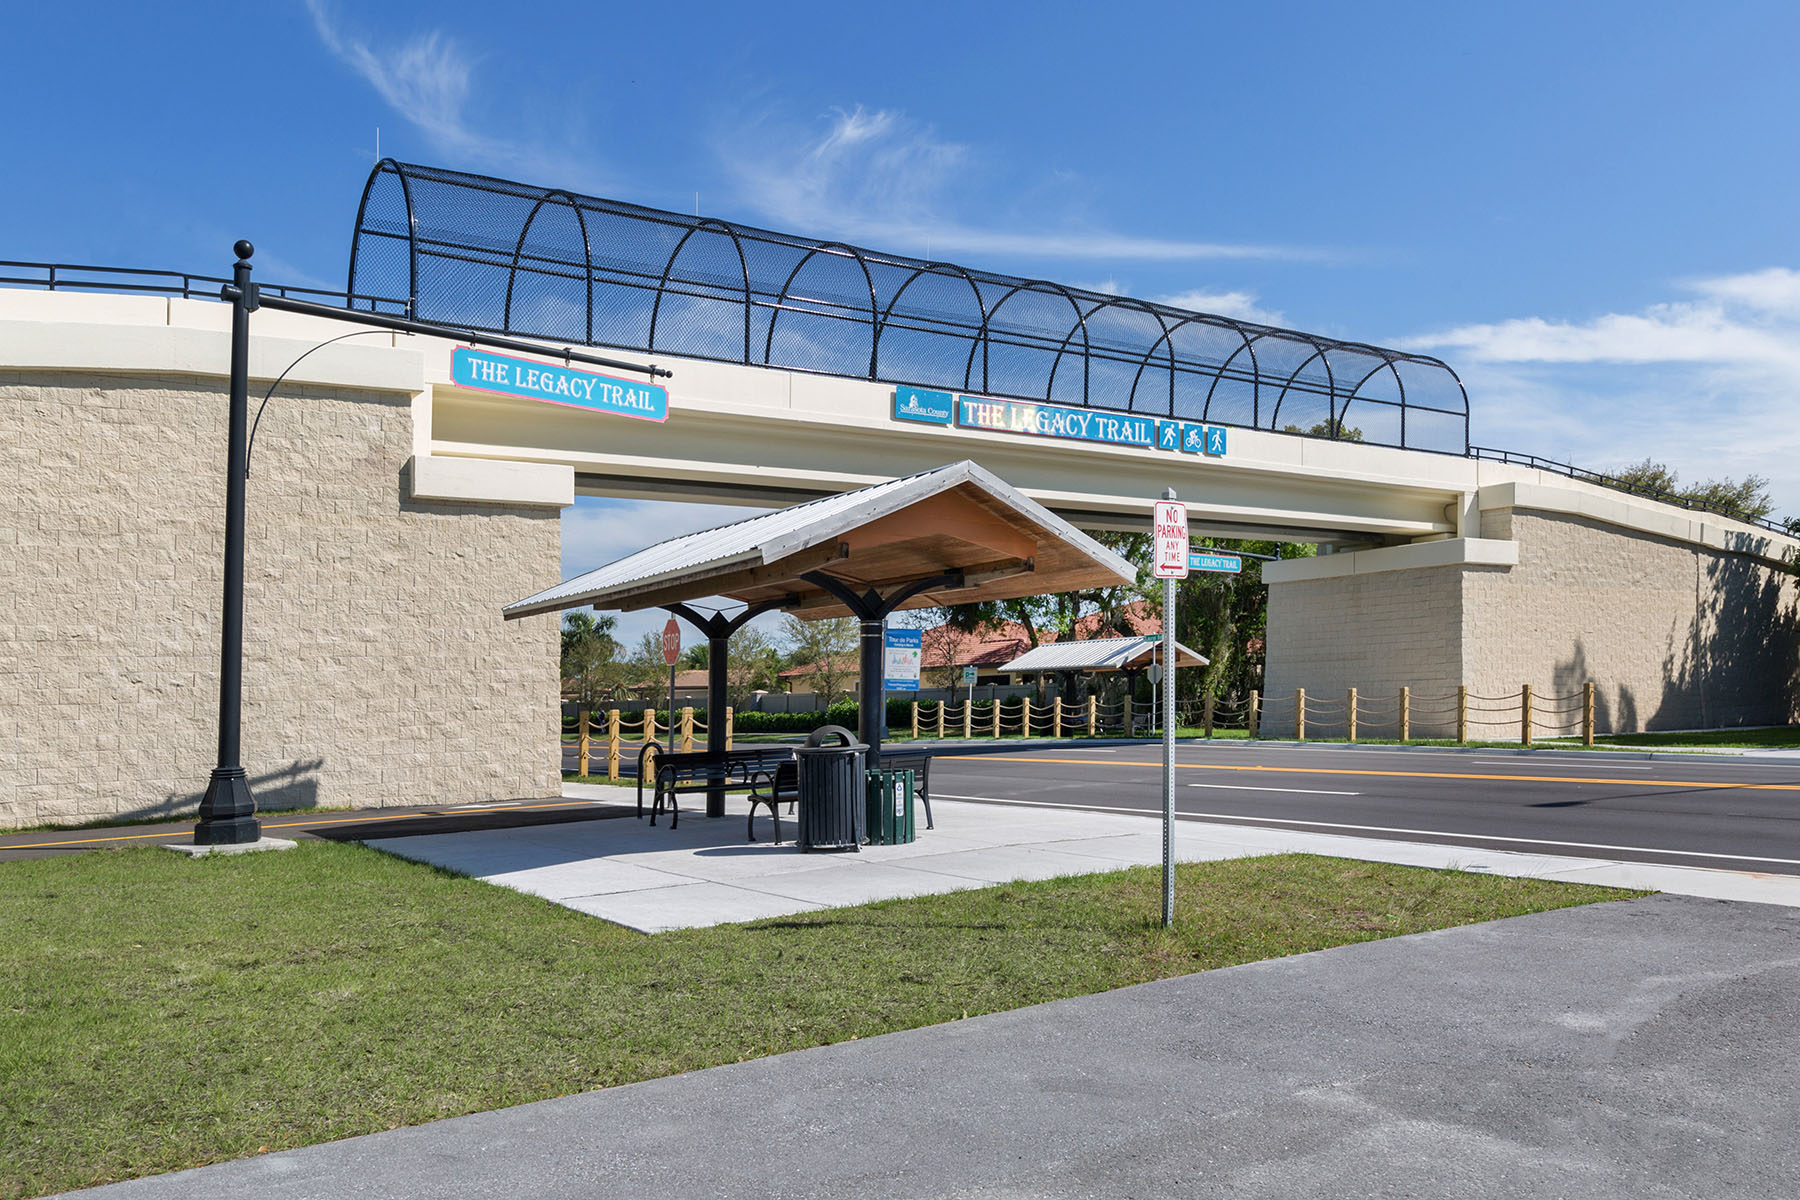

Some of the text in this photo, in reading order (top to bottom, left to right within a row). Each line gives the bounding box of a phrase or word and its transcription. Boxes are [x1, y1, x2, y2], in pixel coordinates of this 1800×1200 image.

[467, 357, 656, 412] THE LEGACY TRAIL
[963, 401, 1152, 444] THE LEGACY TRAIL
[1166, 509, 1179, 524] NO
[1157, 524, 1186, 540] PARKING
[1165, 541, 1179, 551] ANY
[1164, 551, 1180, 562] TIME
[1190, 557, 1238, 569] THE LEGACY TRAIL
[663, 633, 680, 651] STOP
